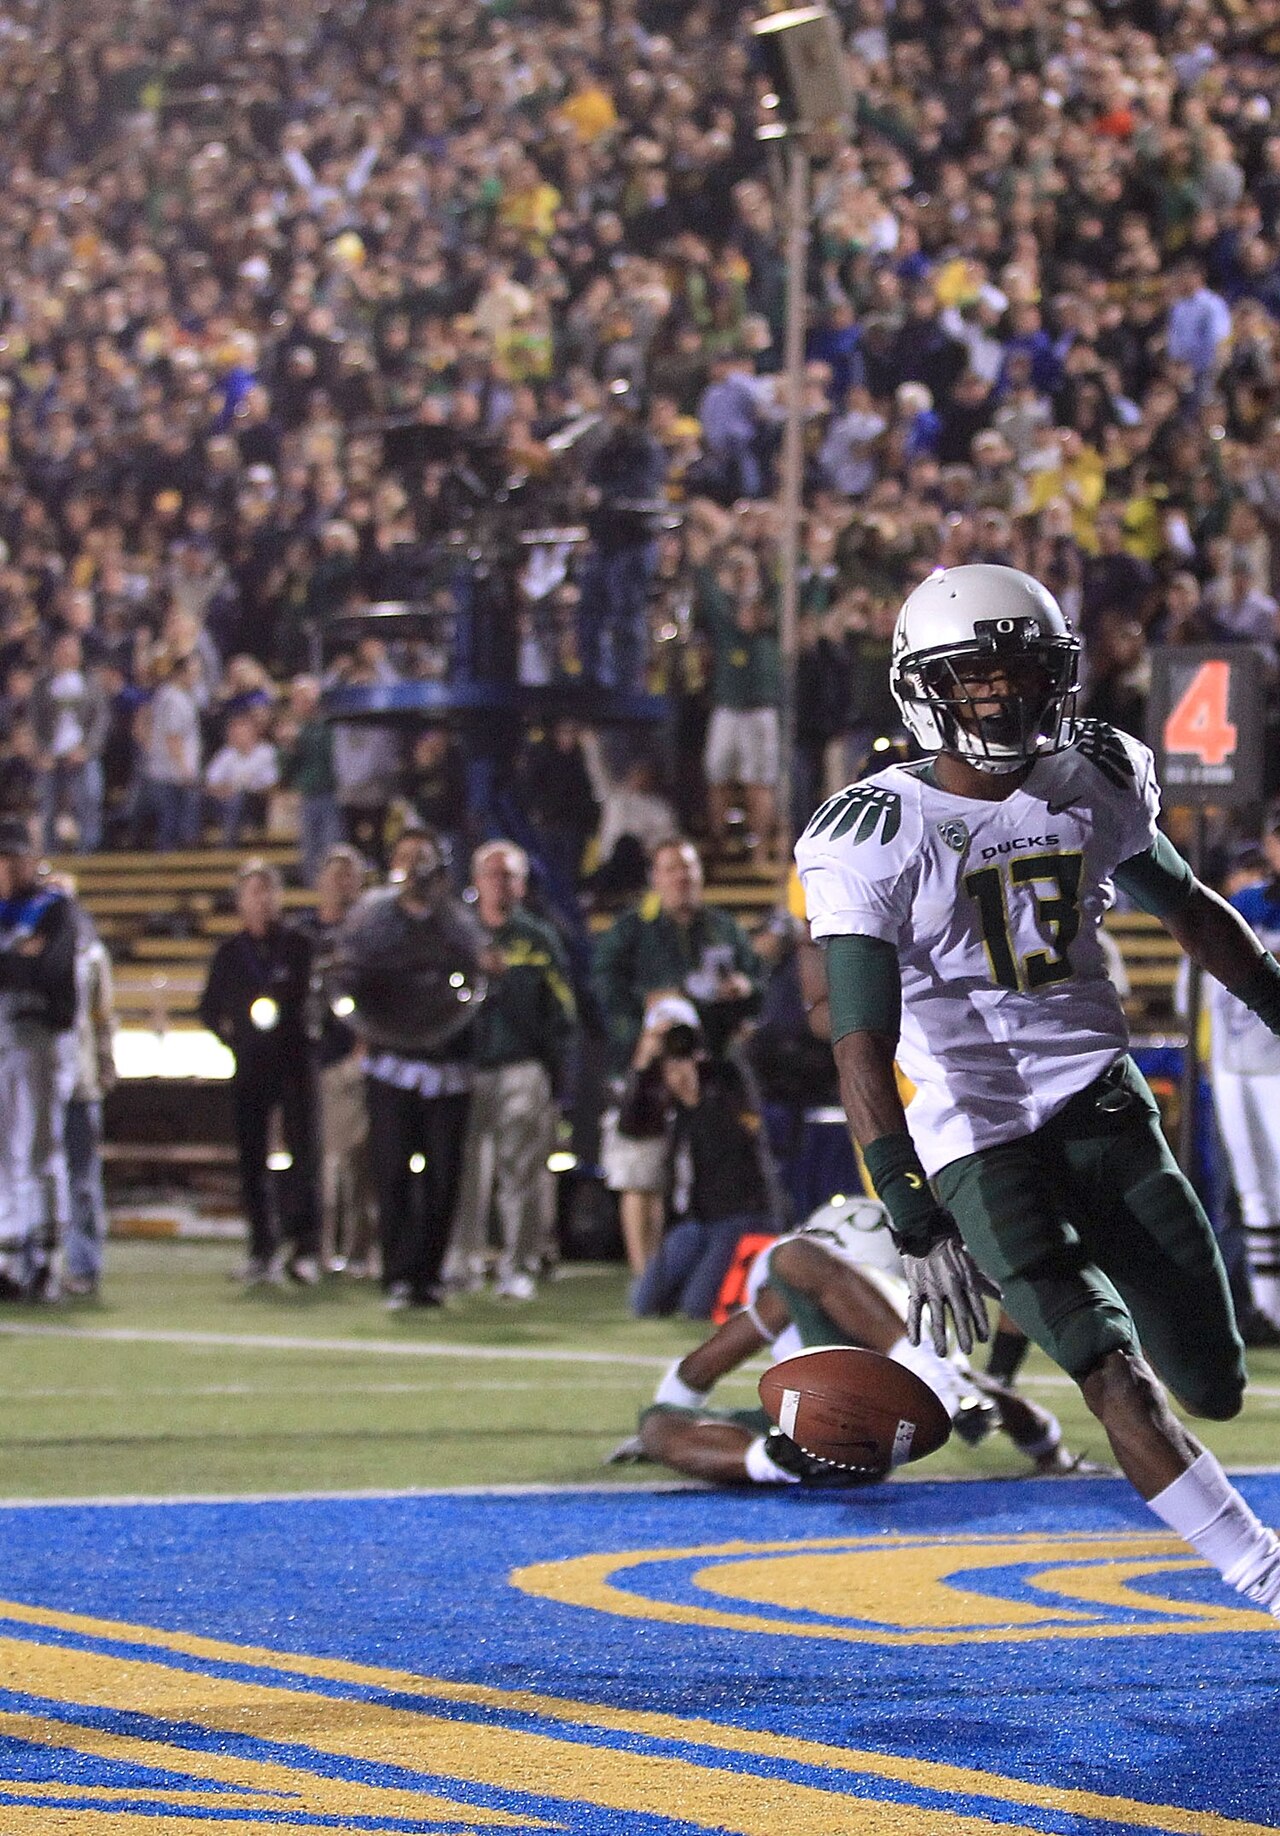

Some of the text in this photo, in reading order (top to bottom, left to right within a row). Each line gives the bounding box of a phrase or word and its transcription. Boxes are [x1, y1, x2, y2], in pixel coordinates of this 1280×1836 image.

[1165, 659, 1238, 765] 4
[981, 834, 1060, 860] DUCKS
[962, 850, 1084, 992] 13
